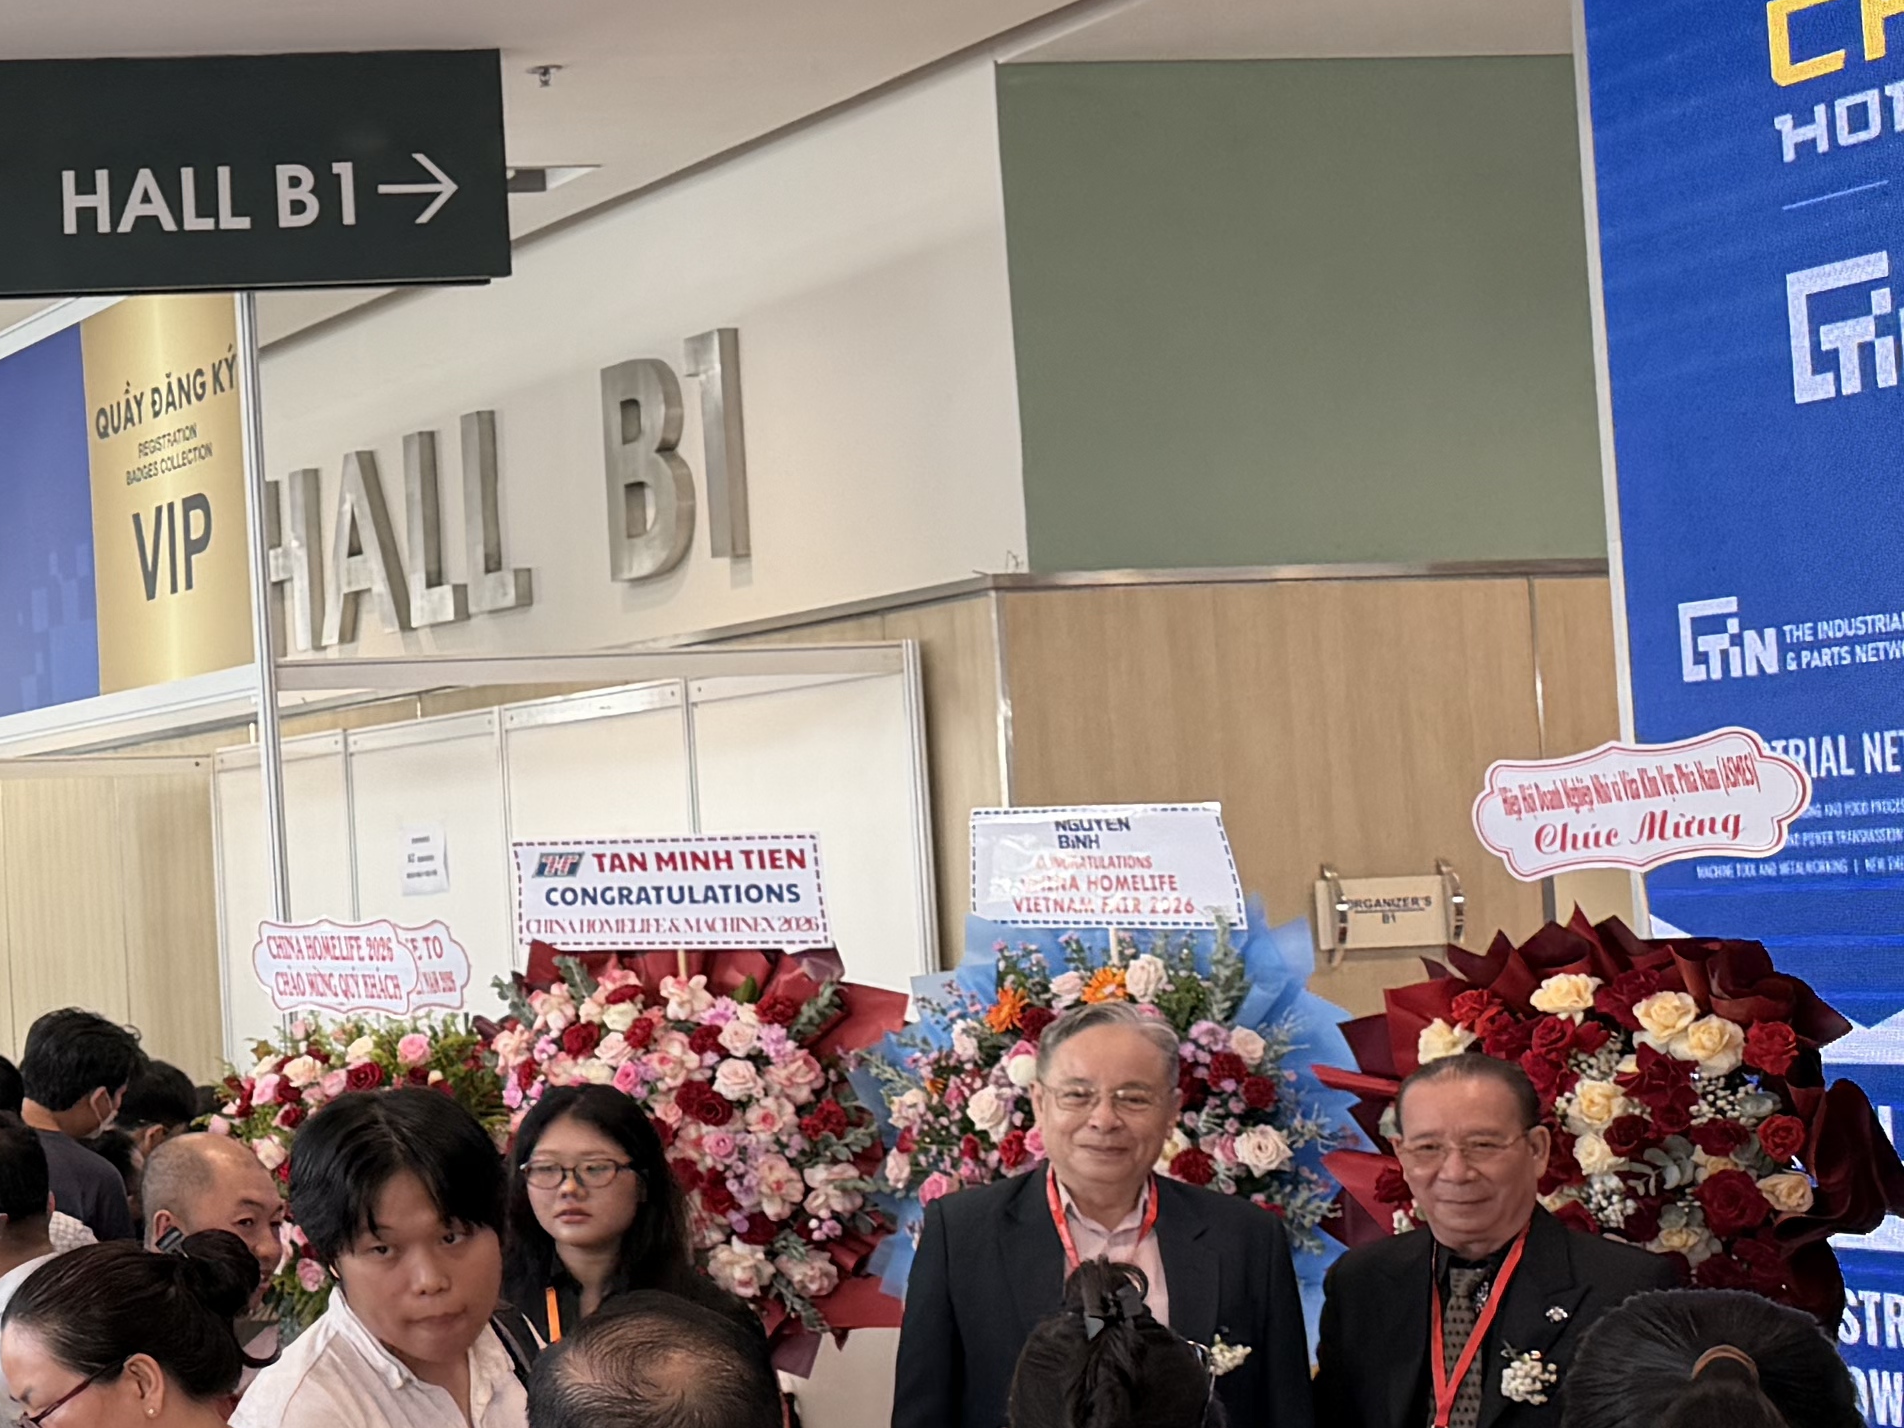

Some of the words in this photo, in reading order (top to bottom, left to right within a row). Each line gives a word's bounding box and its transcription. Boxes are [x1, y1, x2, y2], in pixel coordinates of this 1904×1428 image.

[61, 165, 250, 235] HALL
[278, 161, 357, 228] B1
[151, 367, 207, 419] ĐĂNG
[211, 343, 238, 395] KÝ
[138, 423, 198, 459] REGISTRATION
[126, 460, 159, 486] BADGES
[160, 442, 213, 475] COLLECTION
[266, 409, 534, 657] HALL
[600, 328, 752, 582] B1
[131, 492, 213, 602] VIP
[1782, 623, 1814, 643] THE
[1786, 651, 1798, 671] &
[1801, 645, 1852, 668] PARTS
[1855, 639, 1904, 663] NETW
[1534, 823, 1619, 856] Chúc
[1629, 809, 1746, 846] Mừng
[592, 851, 648, 873] TAN
[654, 849, 734, 872] MINH
[738, 847, 807, 870] TIEN
[544, 883, 801, 906] CONGRATULATIONS
[1087, 874, 1178, 892] HOMELIFE
[1013, 896, 1095, 914] VIETNAM
[1100, 896, 1141, 914] FAIR
[526, 918, 576, 934] CHINA
[578, 917, 667, 934] HOMELIFE
[683, 916, 776, 933] MACHINEX
[778, 915, 820, 933] 2026
[303, 935, 365, 962] HOMELIFE
